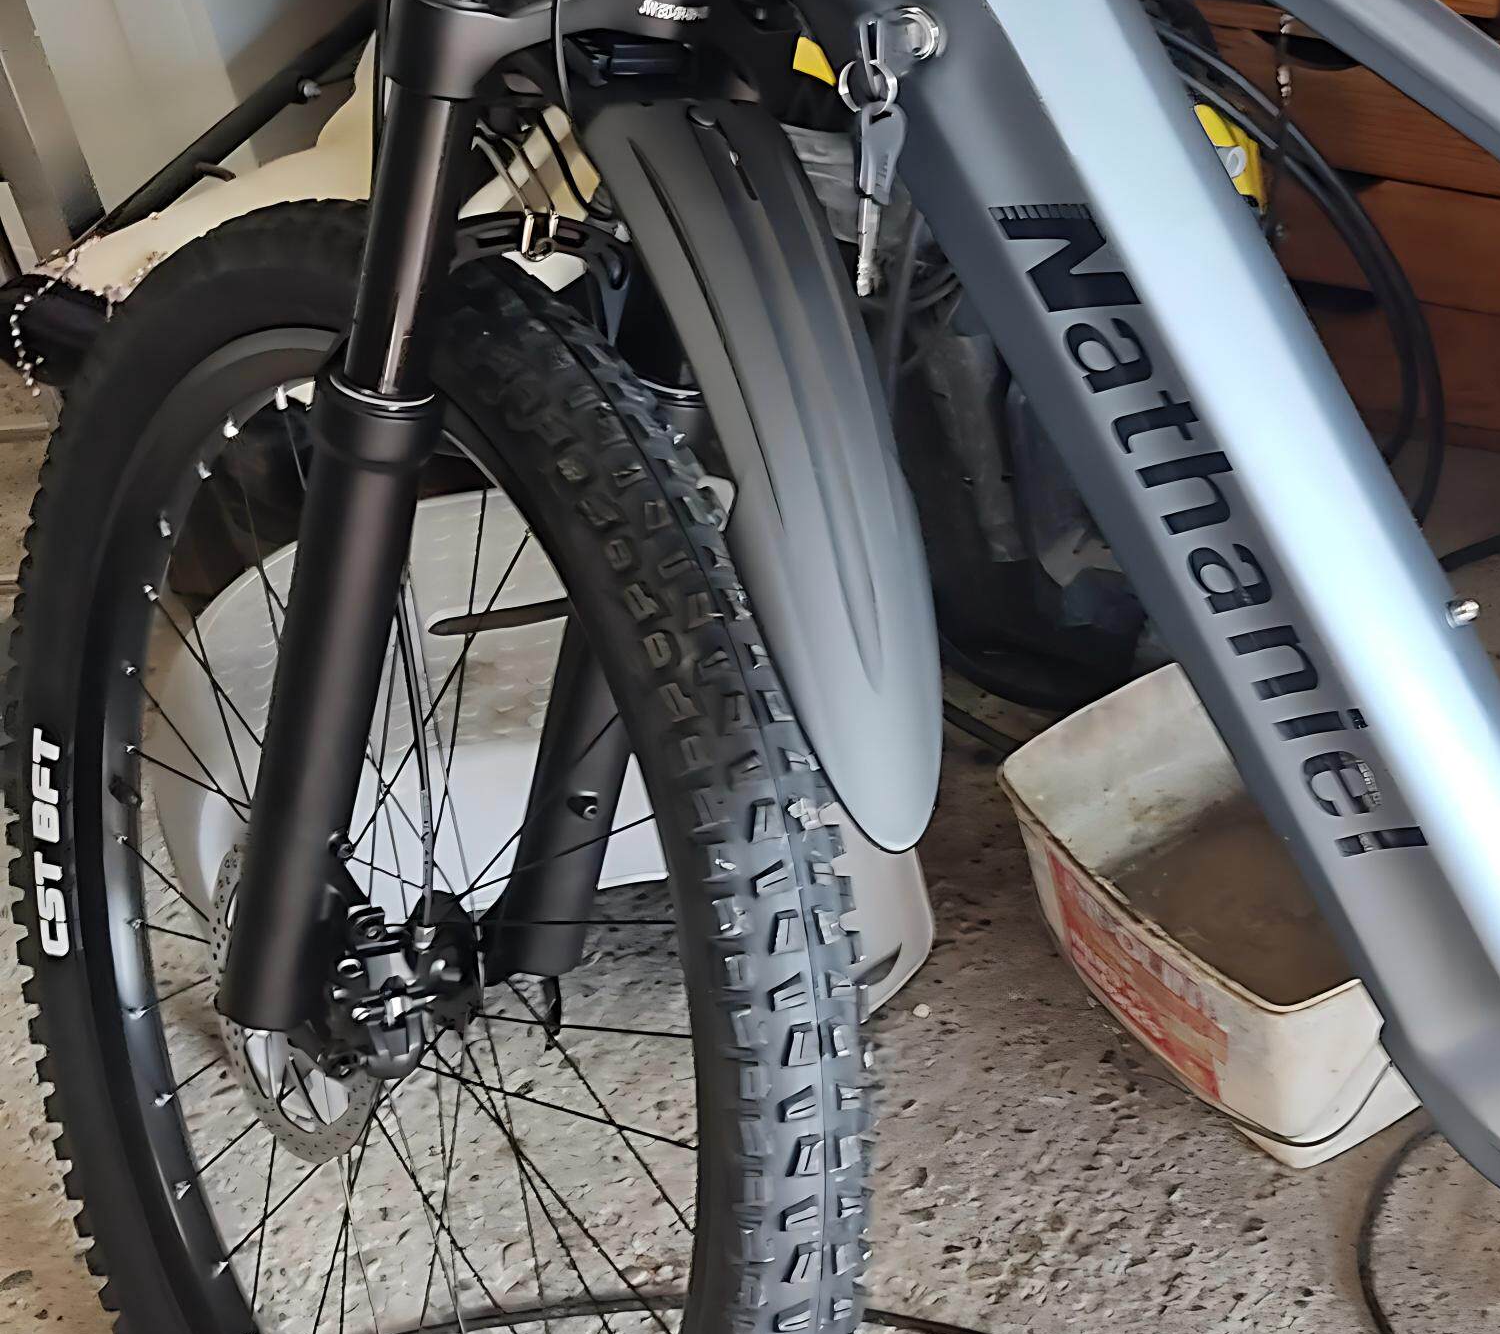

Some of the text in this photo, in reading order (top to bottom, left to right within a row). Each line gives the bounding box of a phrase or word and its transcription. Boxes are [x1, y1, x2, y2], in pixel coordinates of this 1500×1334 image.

[988, 203, 1429, 858] Nathaniel
[31, 726, 71, 958] CST BFT
